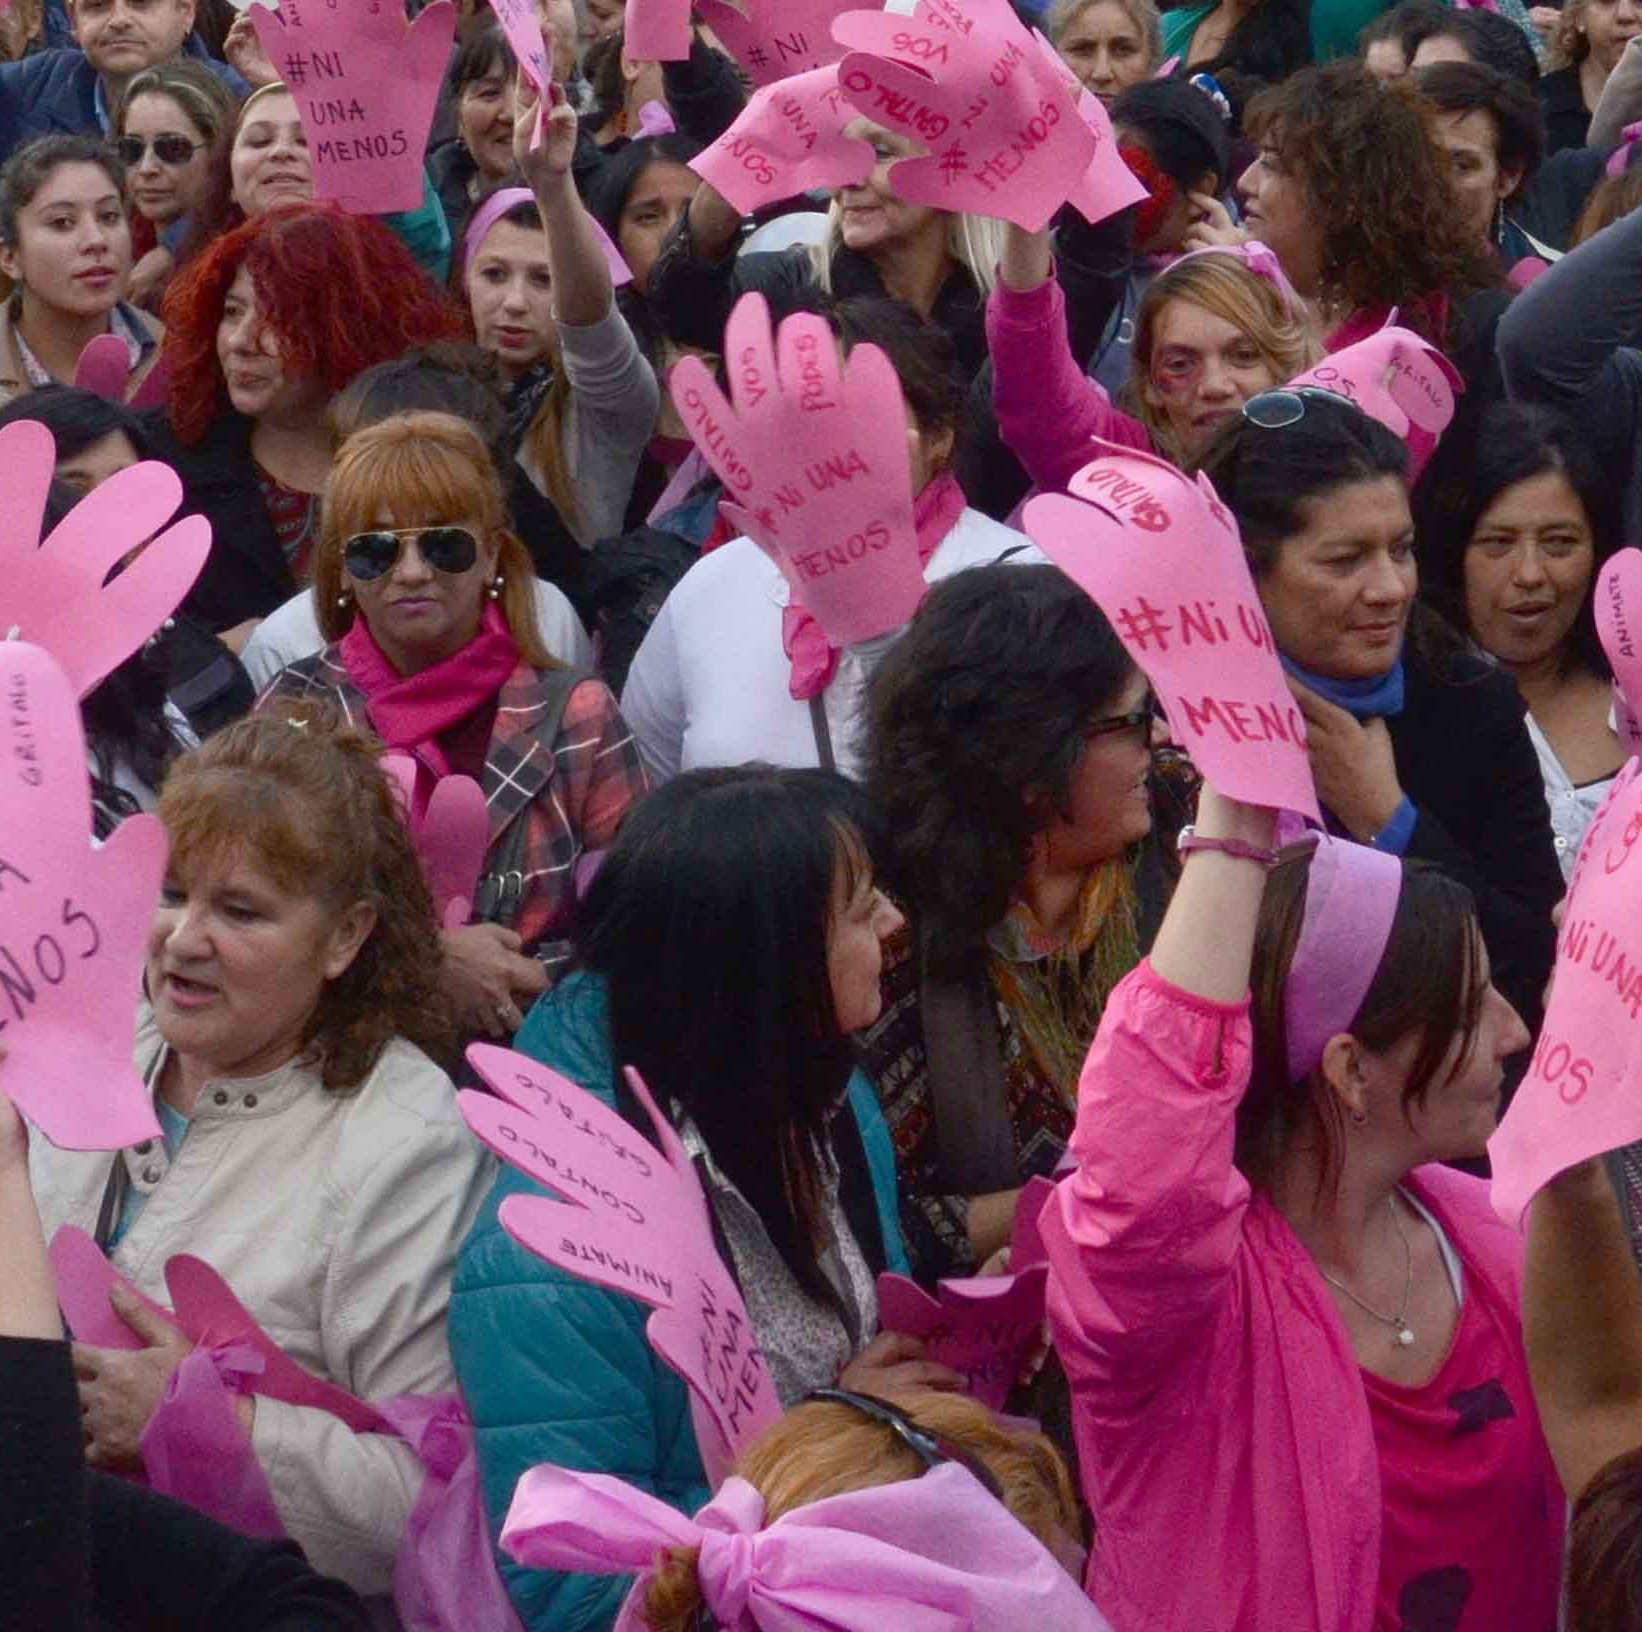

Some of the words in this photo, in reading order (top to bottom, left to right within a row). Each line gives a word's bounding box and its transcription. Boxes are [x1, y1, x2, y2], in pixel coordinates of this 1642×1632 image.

[309, 98, 366, 126] UNA
[317, 130, 409, 164] MENOS
[973, 100, 1062, 193] MENOS
[741, 345, 767, 409] VOS
[684, 388, 754, 493] GRITALO
[804, 448, 873, 491] UNA
[790, 518, 893, 584] MENOS
[15, 671, 45, 788] GRITALO
[497, 1122, 647, 1226] CONTALO
